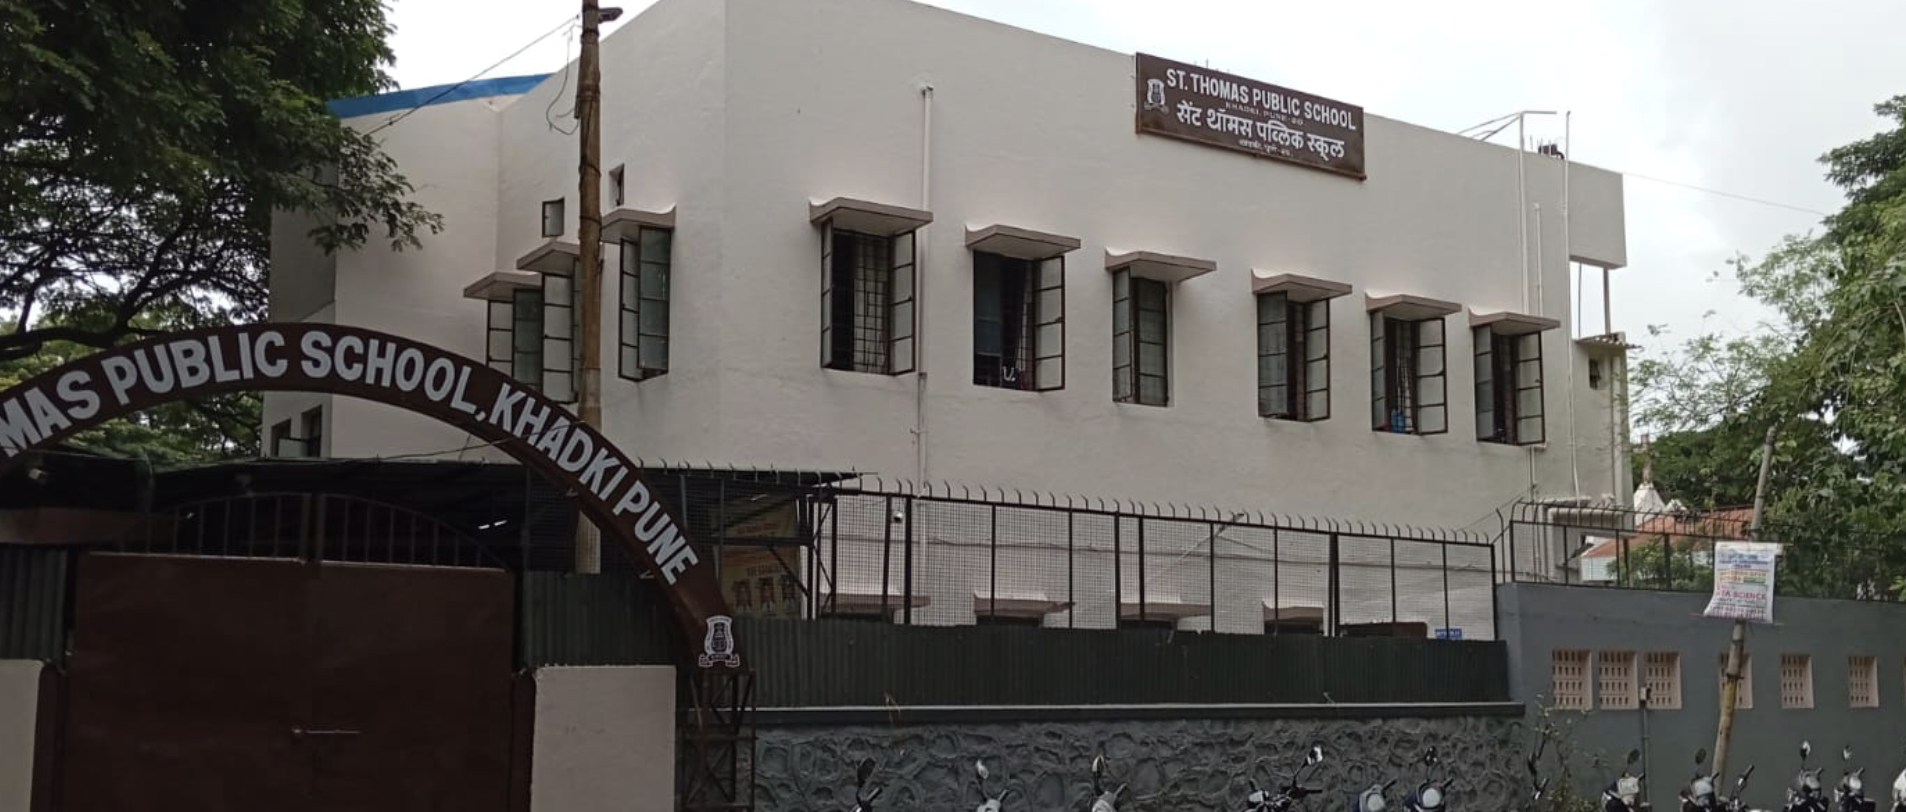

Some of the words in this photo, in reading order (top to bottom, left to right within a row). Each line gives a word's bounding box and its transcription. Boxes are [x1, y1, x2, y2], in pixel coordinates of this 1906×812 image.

[1166, 68, 1188, 91] ST.
[1190, 73, 1249, 104] THOMAS
[1253, 90, 1301, 116] PUBLIC
[1304, 101, 1356, 130] SCHOOL
[1176, 99, 1202, 126] सेंट
[1206, 108, 1253, 138] थॉमस
[1307, 133, 1345, 161] स्कूल
[101, 330, 289, 406] PUBLIC
[300, 330, 487, 422] SCHOOL,
[489, 382, 629, 501] KHADKI
[612, 480, 699, 585] PUNE
